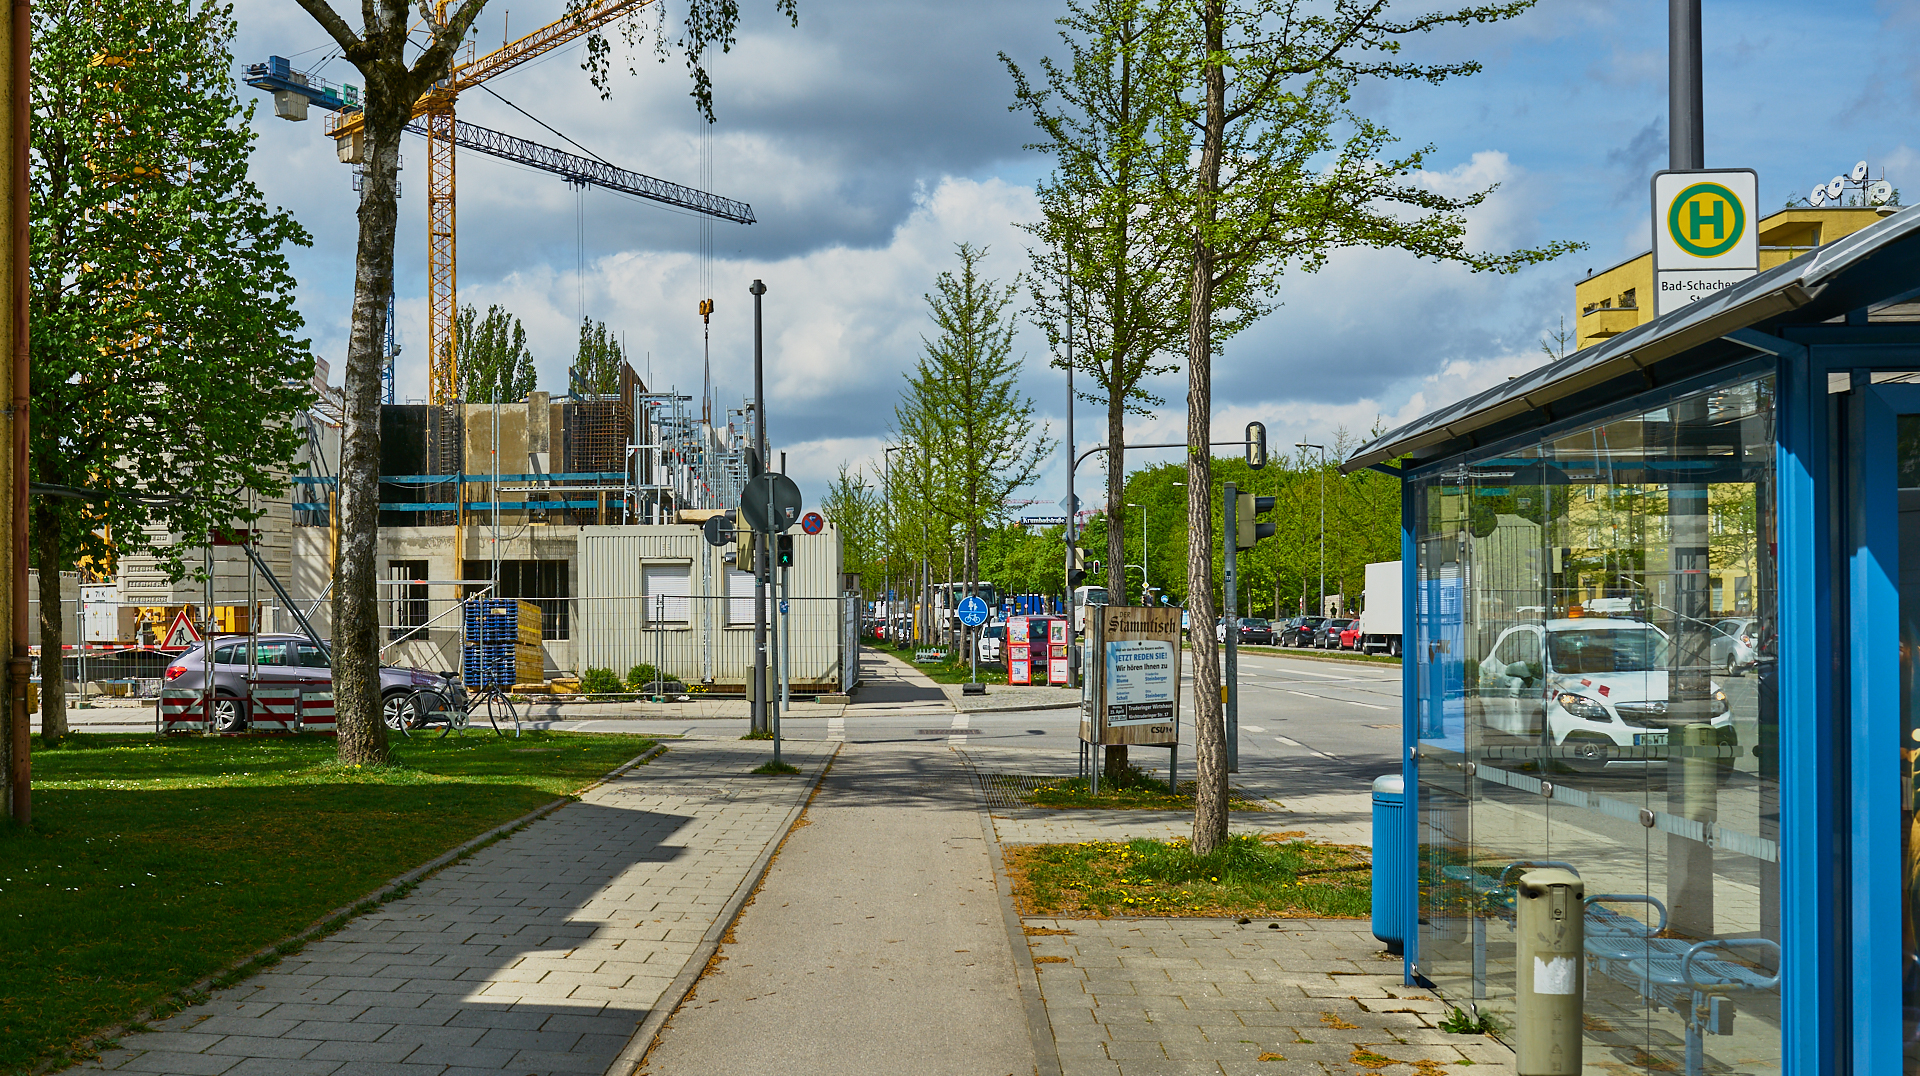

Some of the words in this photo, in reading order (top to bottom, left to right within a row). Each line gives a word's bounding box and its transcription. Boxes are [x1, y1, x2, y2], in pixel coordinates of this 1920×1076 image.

[1690, 201, 1724, 239] H
[1108, 616, 1176, 636] Stammtisch
[1116, 654, 1132, 663] JETZT
[1134, 653, 1154, 661] REDEN
[1155, 652, 1167, 660] SIE!
[1127, 663, 1143, 671] hören
[1151, 726, 1165, 734] CSU
